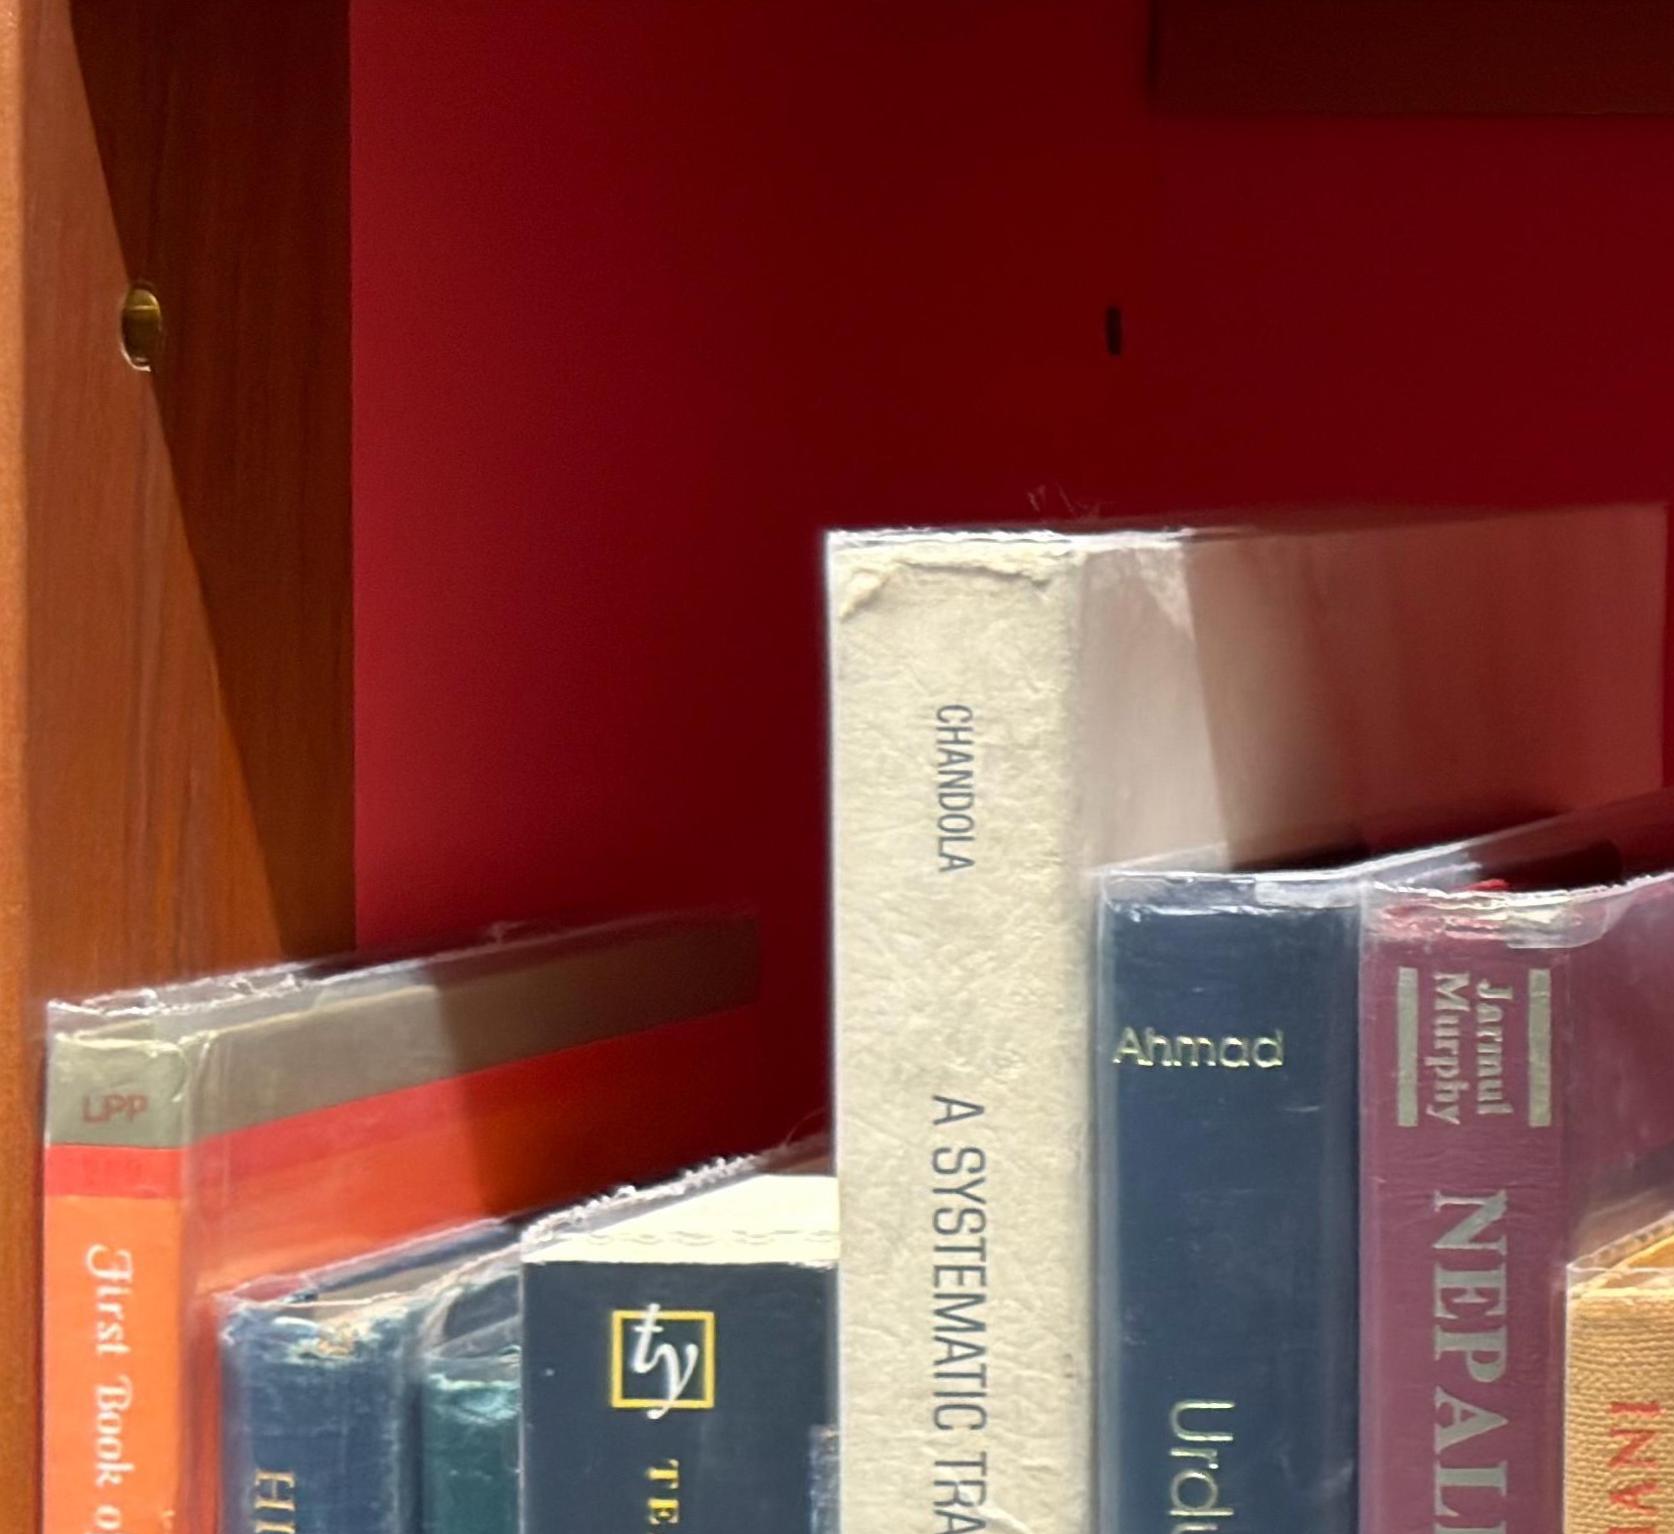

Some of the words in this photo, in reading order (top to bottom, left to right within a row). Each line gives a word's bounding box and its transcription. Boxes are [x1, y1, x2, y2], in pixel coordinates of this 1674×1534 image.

[935, 702, 976, 874] CHANDOLA
[1111, 1025, 1284, 1068] Ahmad
[1423, 970, 1472, 1125] Murphy
[1475, 978, 1514, 1115] Jarmul
[82, 1092, 149, 1124] LPP
[932, 1092, 984, 1125] A
[84, 1244, 135, 1356] First
[932, 1145, 988, 1430] SYSTEMATIC
[92, 1376, 136, 1488] Book
